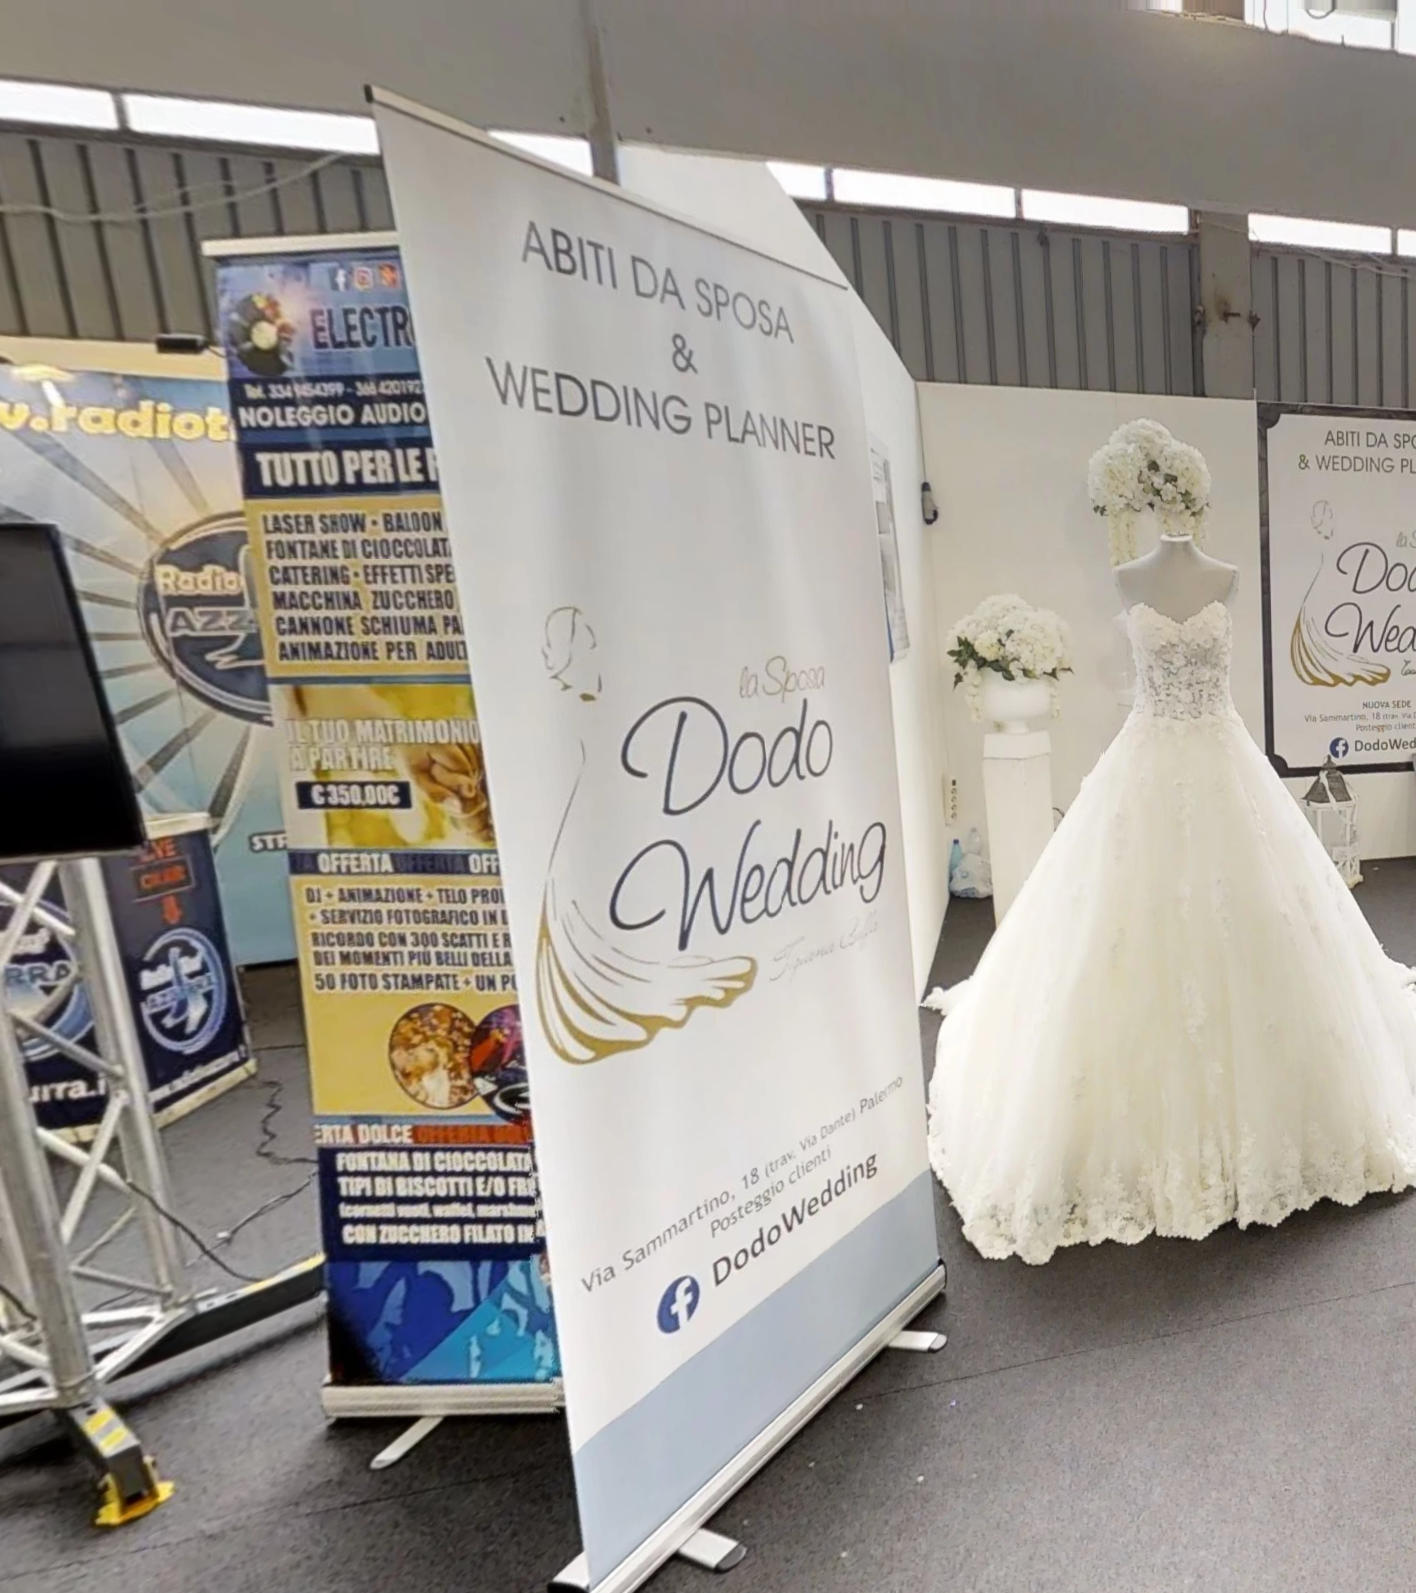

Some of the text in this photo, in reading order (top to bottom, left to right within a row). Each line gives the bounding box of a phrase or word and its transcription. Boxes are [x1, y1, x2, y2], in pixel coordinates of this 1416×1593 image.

[521, 220, 795, 344] ABITI DA SPOSA
[309, 306, 415, 349] ELECTR
[671, 333, 698, 374] &
[238, 402, 426, 428] NOLEGGIO AUDIO
[485, 356, 837, 460] WEDDING PLANNER
[1324, 430, 1361, 447] ABITI
[1366, 432, 1389, 448] DA
[255, 451, 340, 487] TUTTO
[342, 449, 394, 484] PER
[394, 448, 423, 482] LE
[1298, 454, 1310, 471] &
[1315, 455, 1395, 473] WEDDING
[262, 513, 314, 534] LASER
[320, 512, 366, 534] SHOW
[382, 511, 443, 533] BALOON
[266, 540, 339, 560] FONTANE
[342, 539, 358, 559] DI
[269, 565, 350, 586] CATERING
[364, 564, 423, 585] EFFETTI
[426, 563, 456, 584] SPE
[272, 589, 454, 610] MACCHINA ZUCCHERO
[166, 607, 256, 637] AZZ
[275, 616, 464, 636] CANNONE SCHIUMA PA
[279, 641, 379, 661] ANIMAZIONE
[386, 641, 417, 661] PER
[764, 655, 825, 703] Sposa
[1362, 700, 1412, 709] NUOVA SEDE
[1372, 712, 1381, 721] 18
[310, 720, 349, 743] TUO
[355, 719, 479, 744] MATRIMONIO
[309, 746, 393, 770] PARTIRE
[621, 696, 833, 816] Dodo
[317, 854, 395, 874] OFFERTA
[338, 887, 423, 904] ANIMAZIONE
[436, 887, 468, 904] TELO
[609, 819, 887, 951] Wedding
[320, 910, 382, 925] SERVIZIO
[387, 909, 479, 925] FOTOGRAFICO
[483, 910, 497, 924] IN
[311, 932, 375, 948] RICORDO
[379, 932, 409, 948] CON
[411, 932, 439, 948] 300
[442, 932, 488, 948] SCATTI
[492, 932, 500, 948] E
[313, 951, 335, 967] DEI
[339, 950, 405, 967] MOMENTI
[436, 950, 468, 967] BELLI
[315, 973, 335, 990] 50
[340, 973, 378, 990] FOTO
[381, 973, 459, 990] STAMPATE
[475, 973, 498, 990] UN
[357, 1125, 414, 1144] DOLCE
[336, 1153, 411, 1172] FONTANA
[412, 1153, 431, 1172] DI
[337, 1177, 372, 1197] TIPI
[396, 1177, 474, 1197] BISCOTTI
[476, 1177, 505, 1197] E/O
[581, 1265, 616, 1293] Via
[621, 1189, 736, 1272] Sammartino,
[741, 1167, 760, 1190] 18
[799, 1133, 818, 1154] Via
[820, 1109, 856, 1140] Dante)
[858, 1075, 903, 1115] Palermo
[710, 1146, 832, 1238] Posteggio clienti
[711, 1153, 879, 1288] DodoWedding
[342, 1224, 377, 1245] CON
[379, 1224, 461, 1244] ZUCCHERO
[464, 1224, 515, 1244] FILATO
